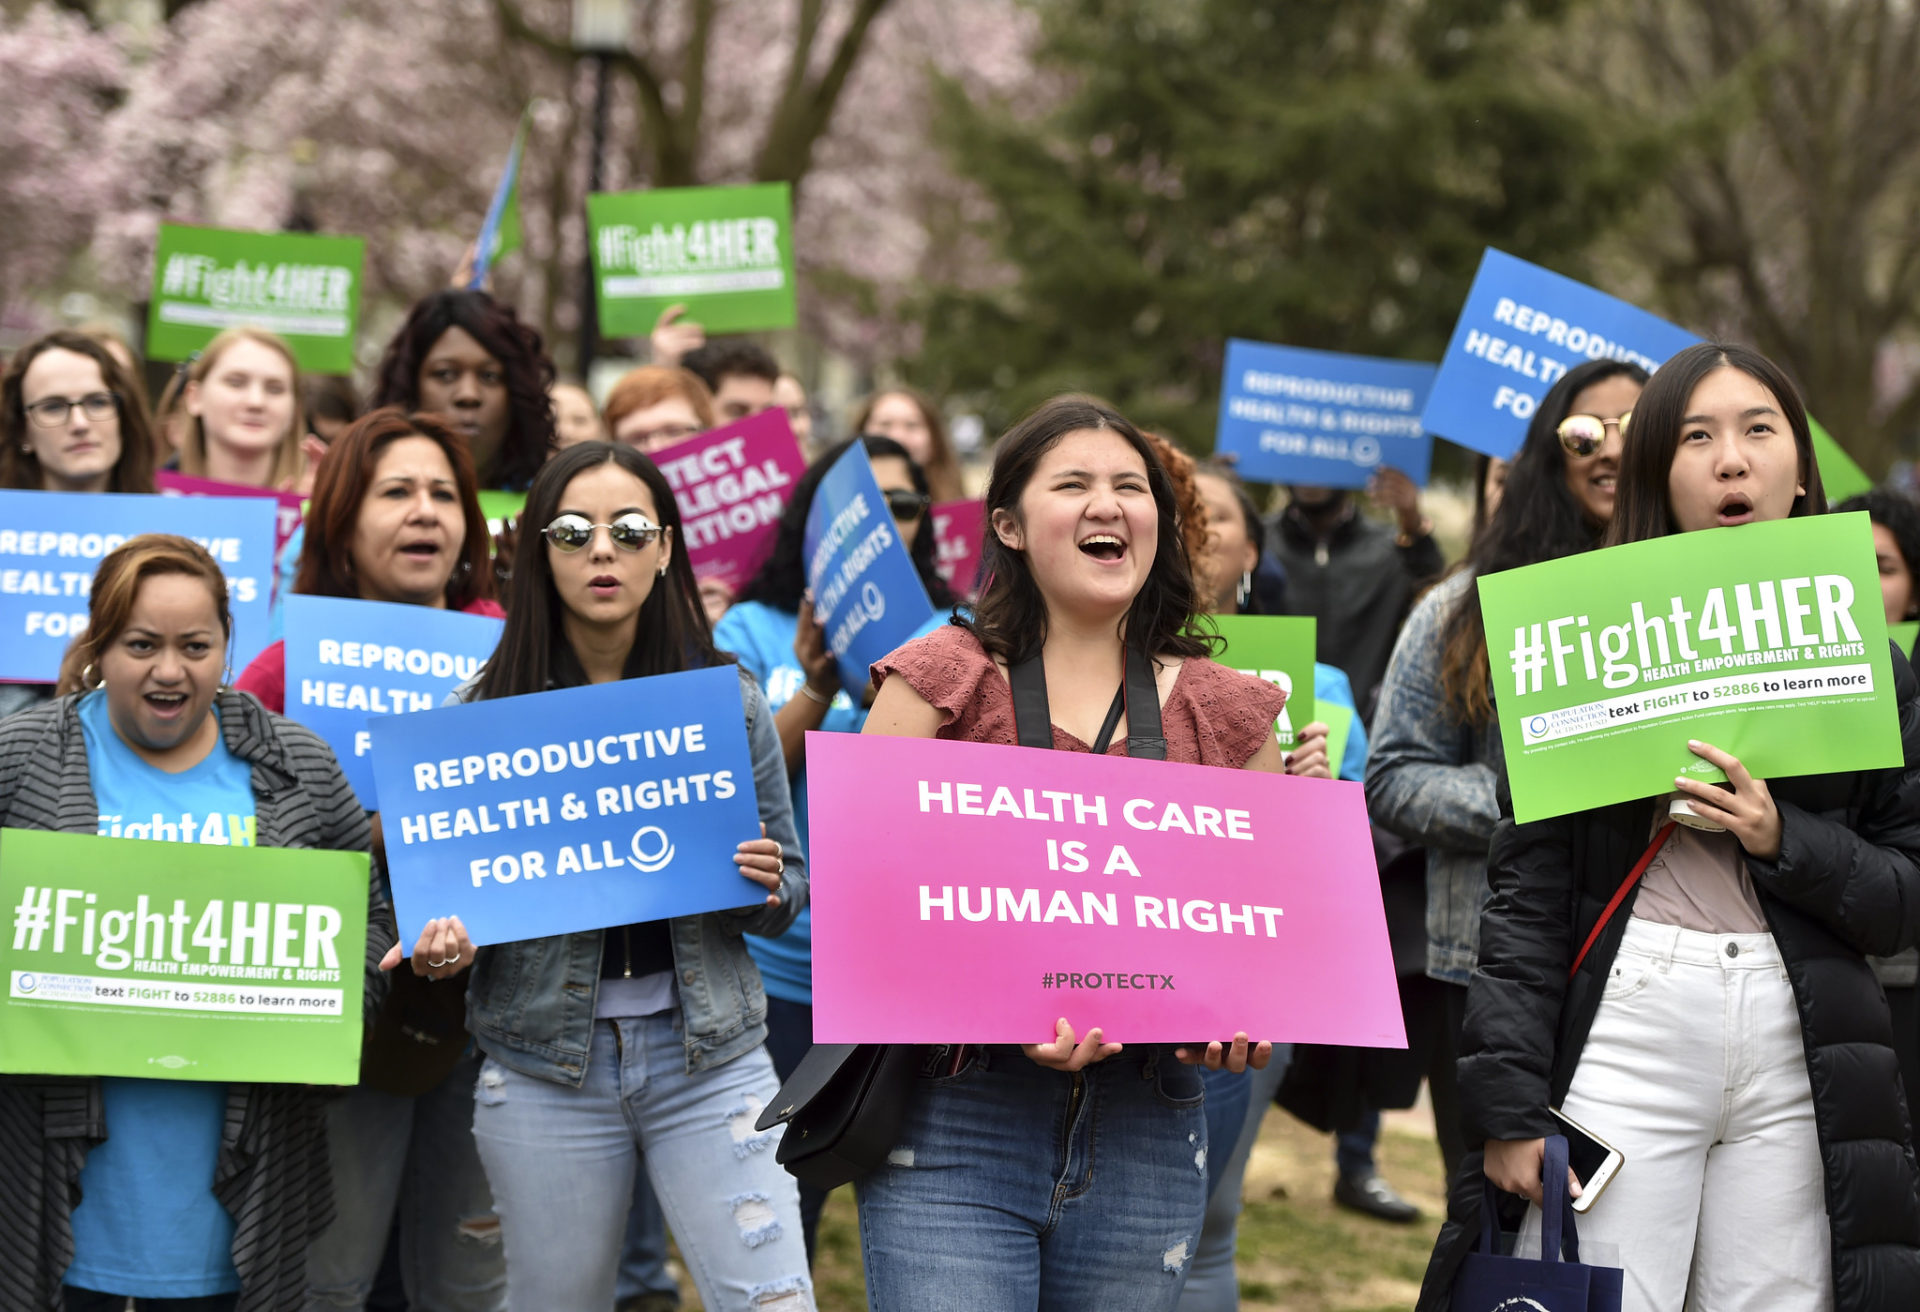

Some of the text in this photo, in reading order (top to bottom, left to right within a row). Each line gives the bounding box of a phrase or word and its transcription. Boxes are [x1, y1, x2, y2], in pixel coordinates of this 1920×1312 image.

[1494, 297, 1660, 378] REPRODU
[1243, 370, 1414, 412] REPRODUCTIVE
[1493, 385, 1541, 419] FO
[661, 436, 746, 490] TECT
[0, 529, 241, 564] REPRODVE
[0, 569, 92, 597] EALT
[1509, 574, 1862, 696] #Fight4HER
[319, 639, 488, 682] REPRODU
[1642, 642, 1865, 682] HEALTH EMPOWERMENT & RIGHTS
[302, 679, 432, 714] HEALTH
[1551, 703, 1604, 719] POPULATION
[1609, 674, 1867, 718] text FIGHT to 52886 to learn more
[413, 724, 706, 791] REPRODUCTIVE
[401, 771, 736, 844] HEALTH & RIGHTS
[918, 780, 1254, 841] HEALTH CARE
[469, 841, 624, 887] FOR ALL
[1046, 839, 1142, 877] IS A
[12, 886, 342, 970] #Fight4HER
[919, 885, 1284, 938] HUMAN RIGHT
[133, 960, 340, 982] HEALTH EMPOWERMENT & RIGHTS
[1042, 972, 1175, 990] #PROTECTX
[95, 985, 124, 997] text
[128, 987, 171, 1000] FIGHT
[174, 991, 190, 1001] to
[193, 992, 236, 1004] 52886
[239, 994, 255, 1005] to
[258, 994, 295, 1007] learn
[299, 997, 336, 1008] more
